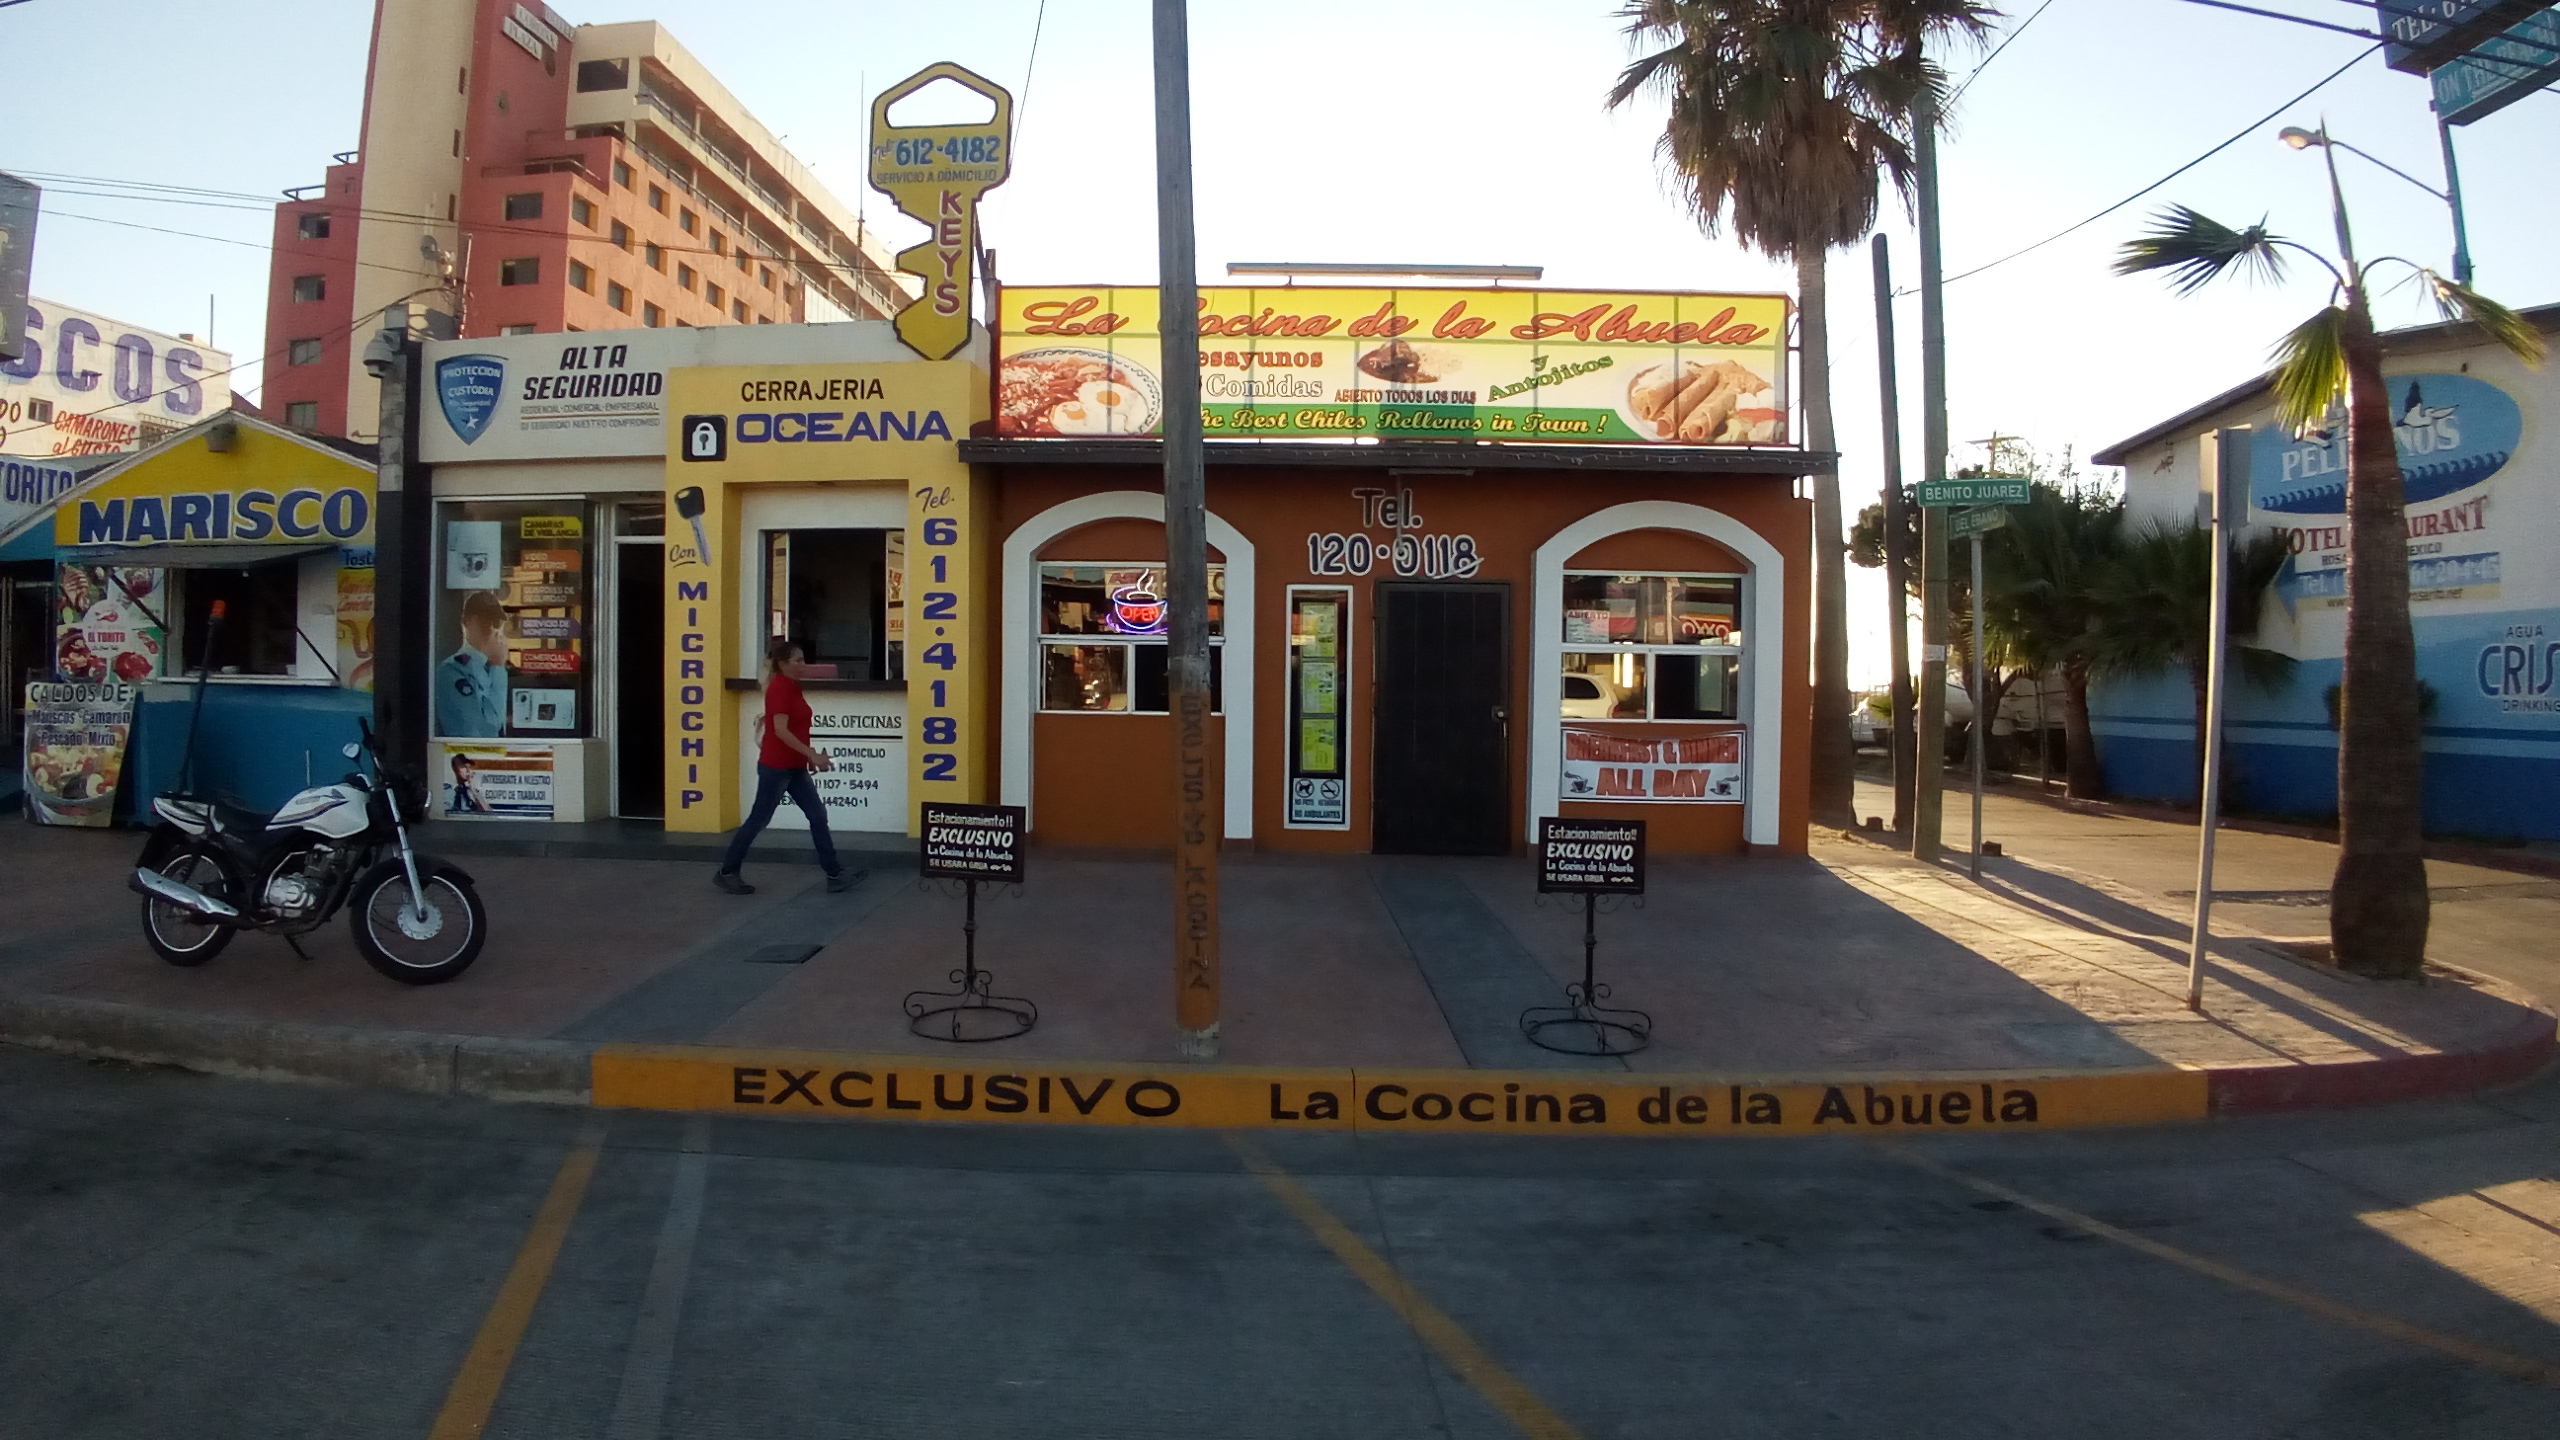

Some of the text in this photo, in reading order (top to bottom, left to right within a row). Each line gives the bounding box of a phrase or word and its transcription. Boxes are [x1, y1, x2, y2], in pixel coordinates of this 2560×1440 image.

[876, 169, 997, 184] SERVICIO A DOMICILIO
[934, 189, 963, 316] KEYS
[1022, 296, 1770, 345] La ocina de la Abuela
[559, 345, 628, 371] ALTA
[1199, 351, 1324, 372] esayunos
[443, 365, 502, 379] PROTECCION
[468, 376, 475, 385] Y
[1486, 354, 1614, 403] Antojitos
[448, 385, 495, 397] CUSTODIA
[522, 372, 663, 401] SEGURIDAD
[741, 378, 885, 402] CERRAJERIA
[1206, 373, 1324, 398] Comidas
[606, 401, 659, 412] EMPRESARIAL
[1334, 389, 1477, 405] ABIERTO TODOS LOS DIAS
[54, 410, 137, 446] CAMARONES
[736, 410, 953, 443] OCEANA
[1200, 407, 1225, 429] he
[1230, 408, 1289, 430] Best
[1293, 408, 1368, 430] Chiles
[1374, 409, 1484, 431] Rellenos
[1489, 414, 1516, 432] in
[1521, 412, 1592, 434] Town
[915, 486, 955, 513] Tel.
[1925, 485, 2025, 501] BENITO JUAREZ
[79, 488, 368, 544] MARISCO
[1352, 487, 1424, 529] Tel.
[669, 544, 697, 562] Con
[1120, 605, 1159, 622] OPEN
[2506, 624, 2544, 639] AGUA
[30, 684, 97, 703] CALDOS
[678, 581, 708, 809] MICROCHIP
[833, 747, 886, 759] DOMICILIO
[839, 762, 863, 773] HRS
[1596, 767, 1712, 798] ALL DAY
[928, 826, 1014, 848] EXCLUSIVO
[927, 844, 1014, 861] La Cocina de la Abuela
[1546, 842, 1634, 861] EXCLUSIVO
[929, 858, 940, 867] SE
[1546, 858, 1635, 873] La Cocina de la Abuela
[1545, 872, 1557, 882] SE
[1557, 873, 1583, 883] USARA
[734, 1066, 2039, 1127] EXCLUSIVO La Cocina de la Abuela
